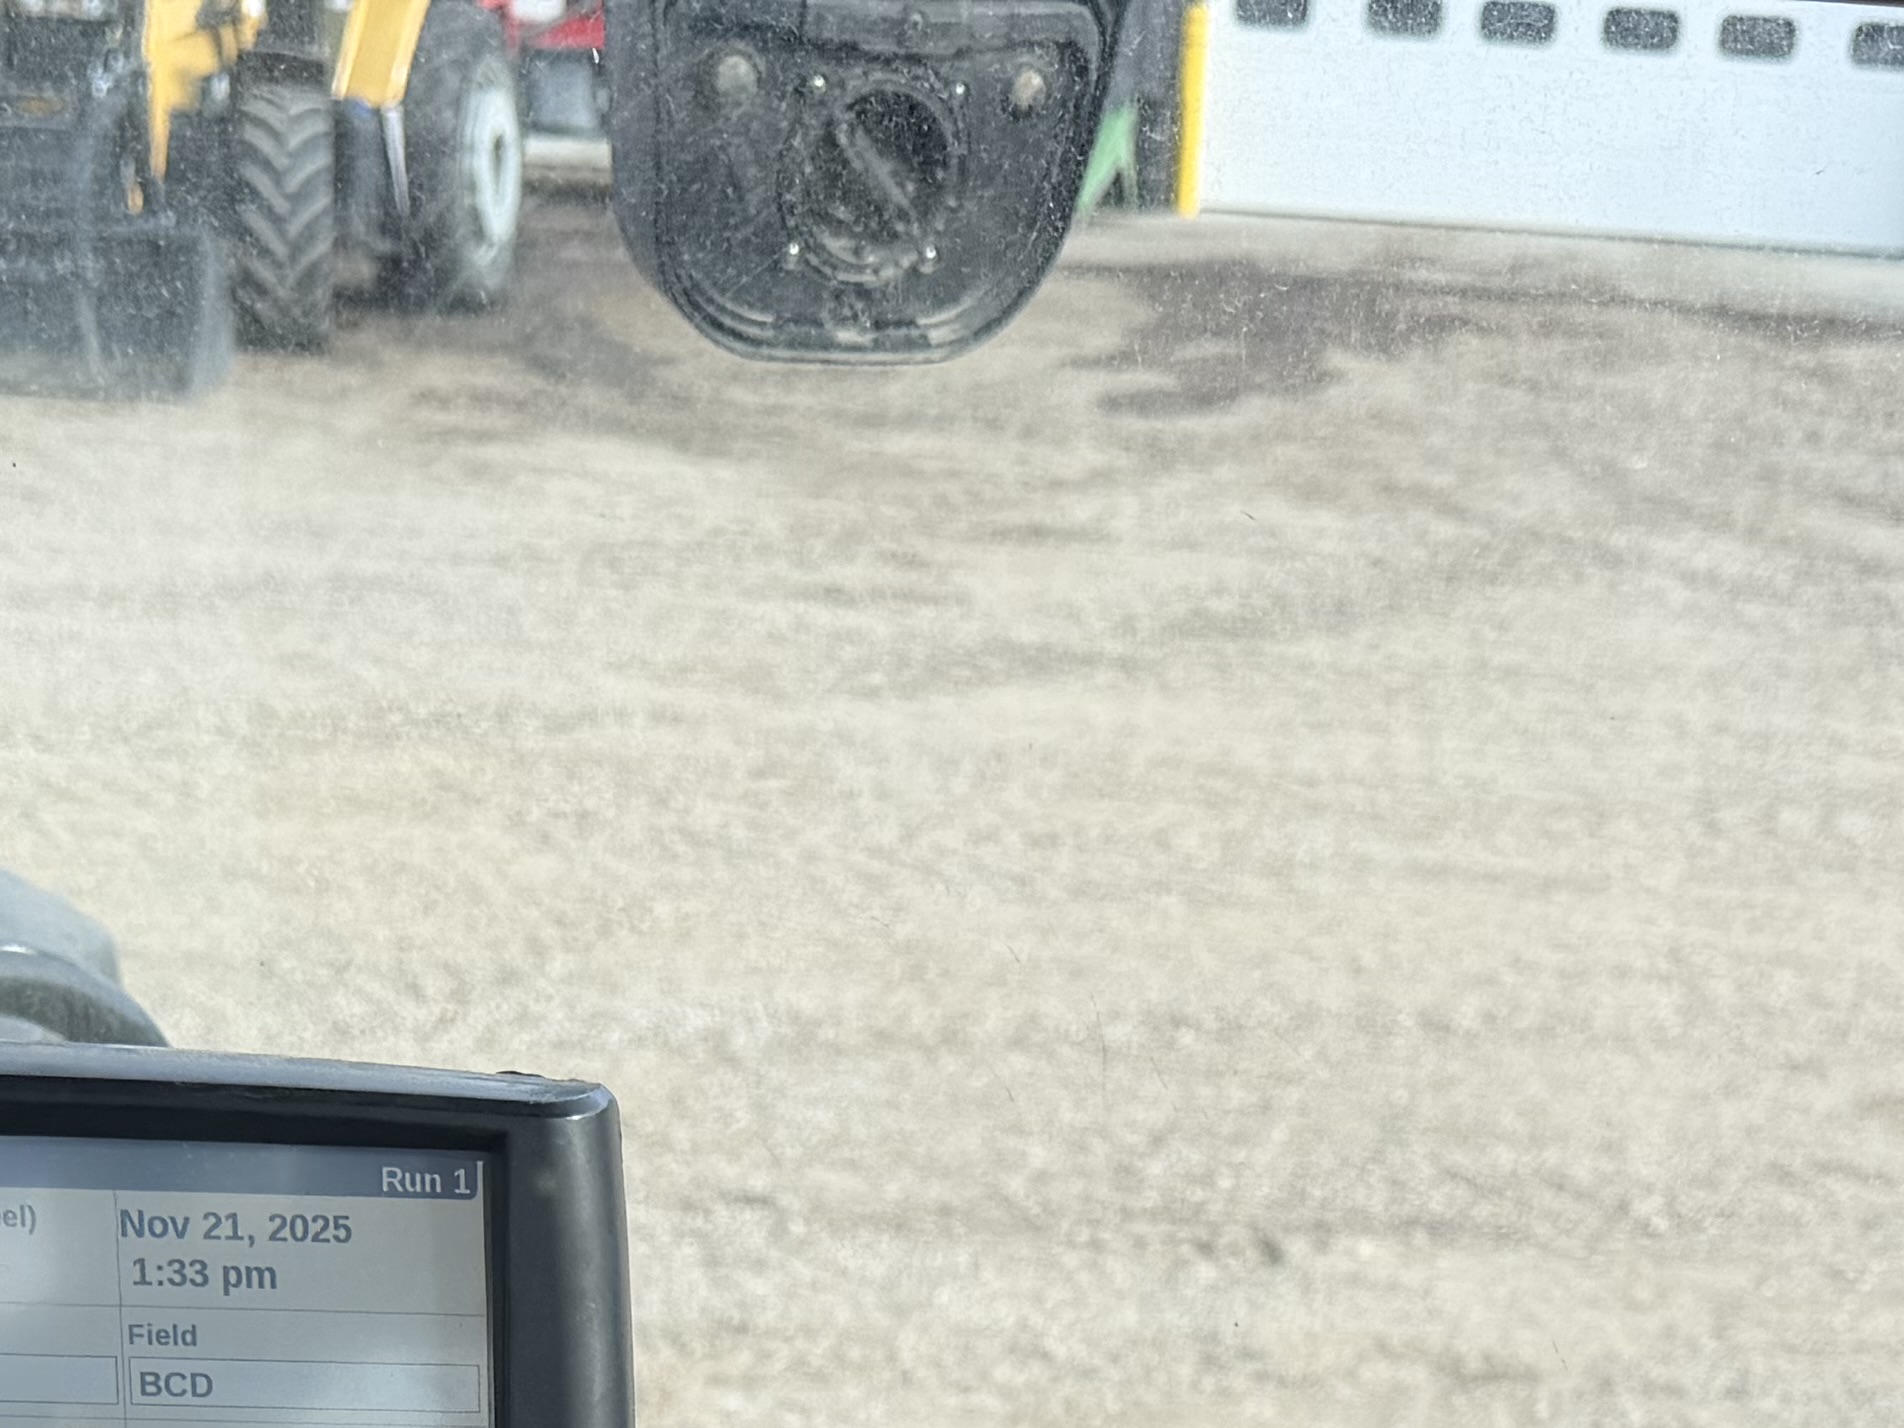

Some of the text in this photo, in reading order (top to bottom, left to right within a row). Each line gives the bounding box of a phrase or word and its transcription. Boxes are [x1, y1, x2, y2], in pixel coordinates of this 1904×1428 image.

[381, 1166, 471, 1195] Run 1
[120, 1209, 353, 1248] Nov 21, 2025
[132, 1258, 278, 1297] 1:33 pm
[128, 1323, 198, 1348] Field
[139, 1371, 214, 1398] BCD
